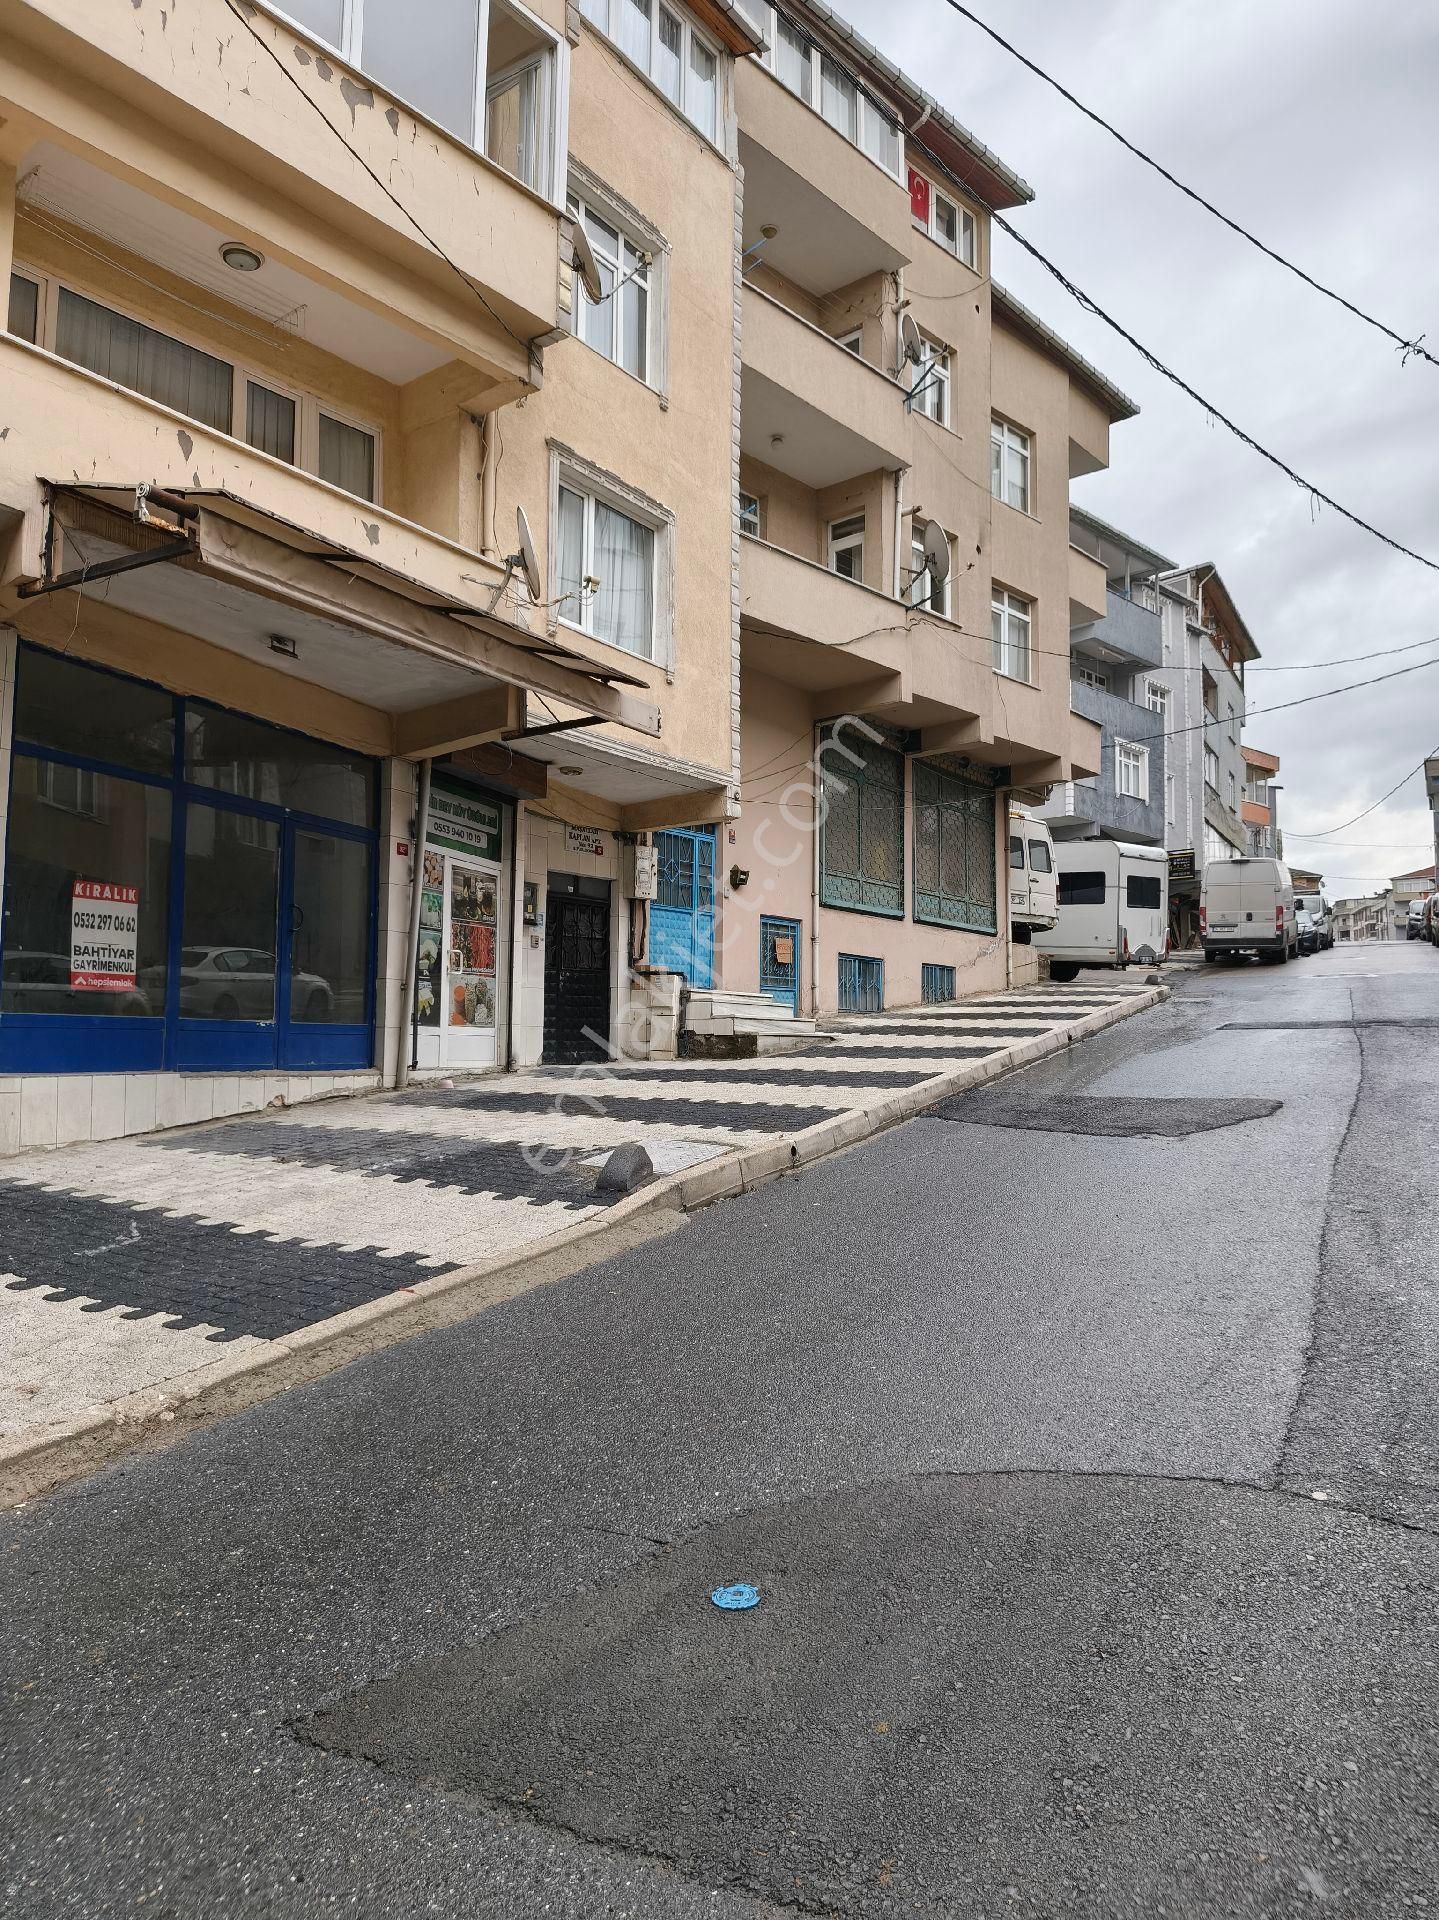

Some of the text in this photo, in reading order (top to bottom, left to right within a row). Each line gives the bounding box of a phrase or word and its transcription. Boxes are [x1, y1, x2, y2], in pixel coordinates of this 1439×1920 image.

[433, 821, 481, 843] 0553 940 10 19
[74, 882, 137, 902] KİRALIK
[73, 911, 136, 932] 0532 297 06 62
[73, 944, 135, 960] BAHTİYAR
[73, 957, 135, 973] GAYRİMENKUL
[88, 976, 133, 988] hepsiemlak
